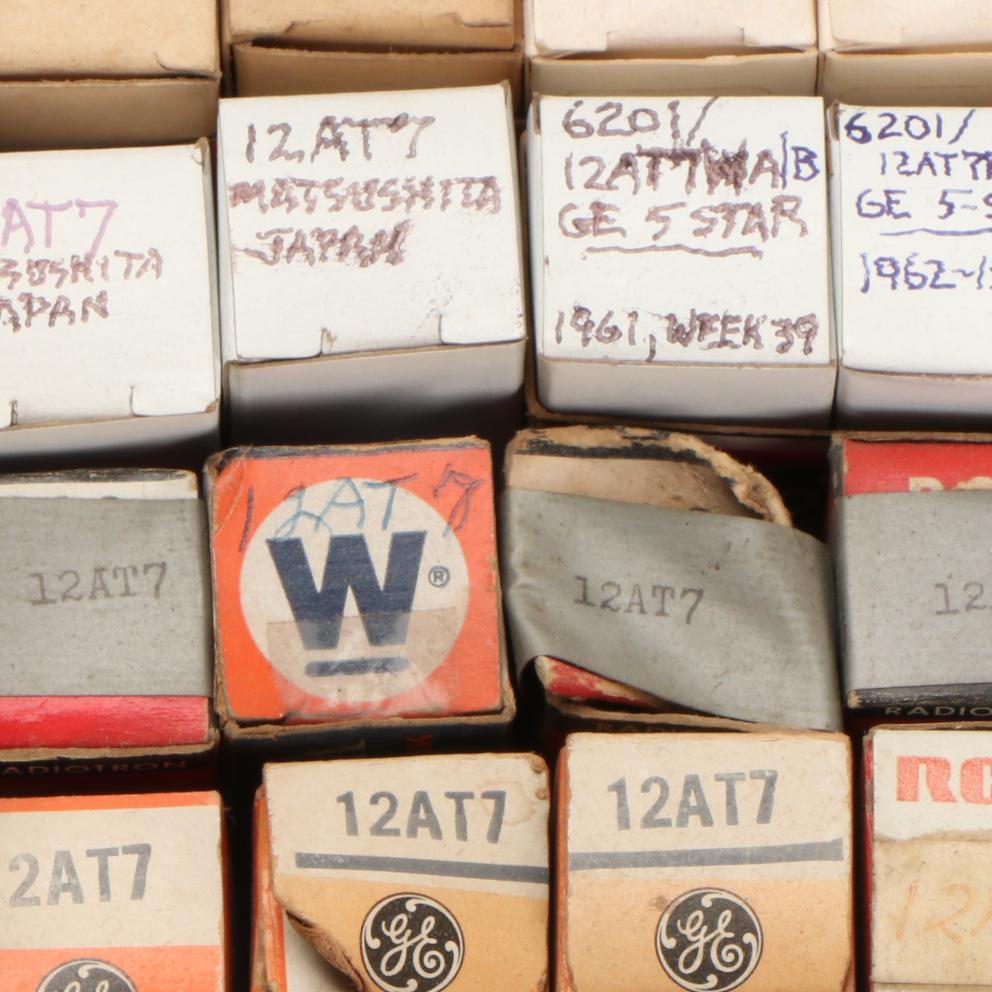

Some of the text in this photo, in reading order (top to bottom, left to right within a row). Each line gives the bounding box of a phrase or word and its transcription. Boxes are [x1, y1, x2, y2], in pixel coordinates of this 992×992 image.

[245, 113, 436, 163] 12AT7
[561, 97, 719, 146] 6201/
[844, 109, 976, 144] 6201/
[228, 175, 502, 215] MATSUSHITA
[558, 195, 810, 242] GE 5 STAR
[856, 189, 911, 219] GE
[238, 219, 412, 268] JAPAN
[664, 309, 764, 351] WEEK
[771, 312, 820, 355] 39
[31, 561, 167, 605] 12AT7
[266, 529, 429, 650] W
[574, 576, 704, 624] 12AT7
[335, 790, 508, 845] 12AT7
[607, 769, 778, 831] 12AT7
[8, 843, 152, 908] 2AT7
